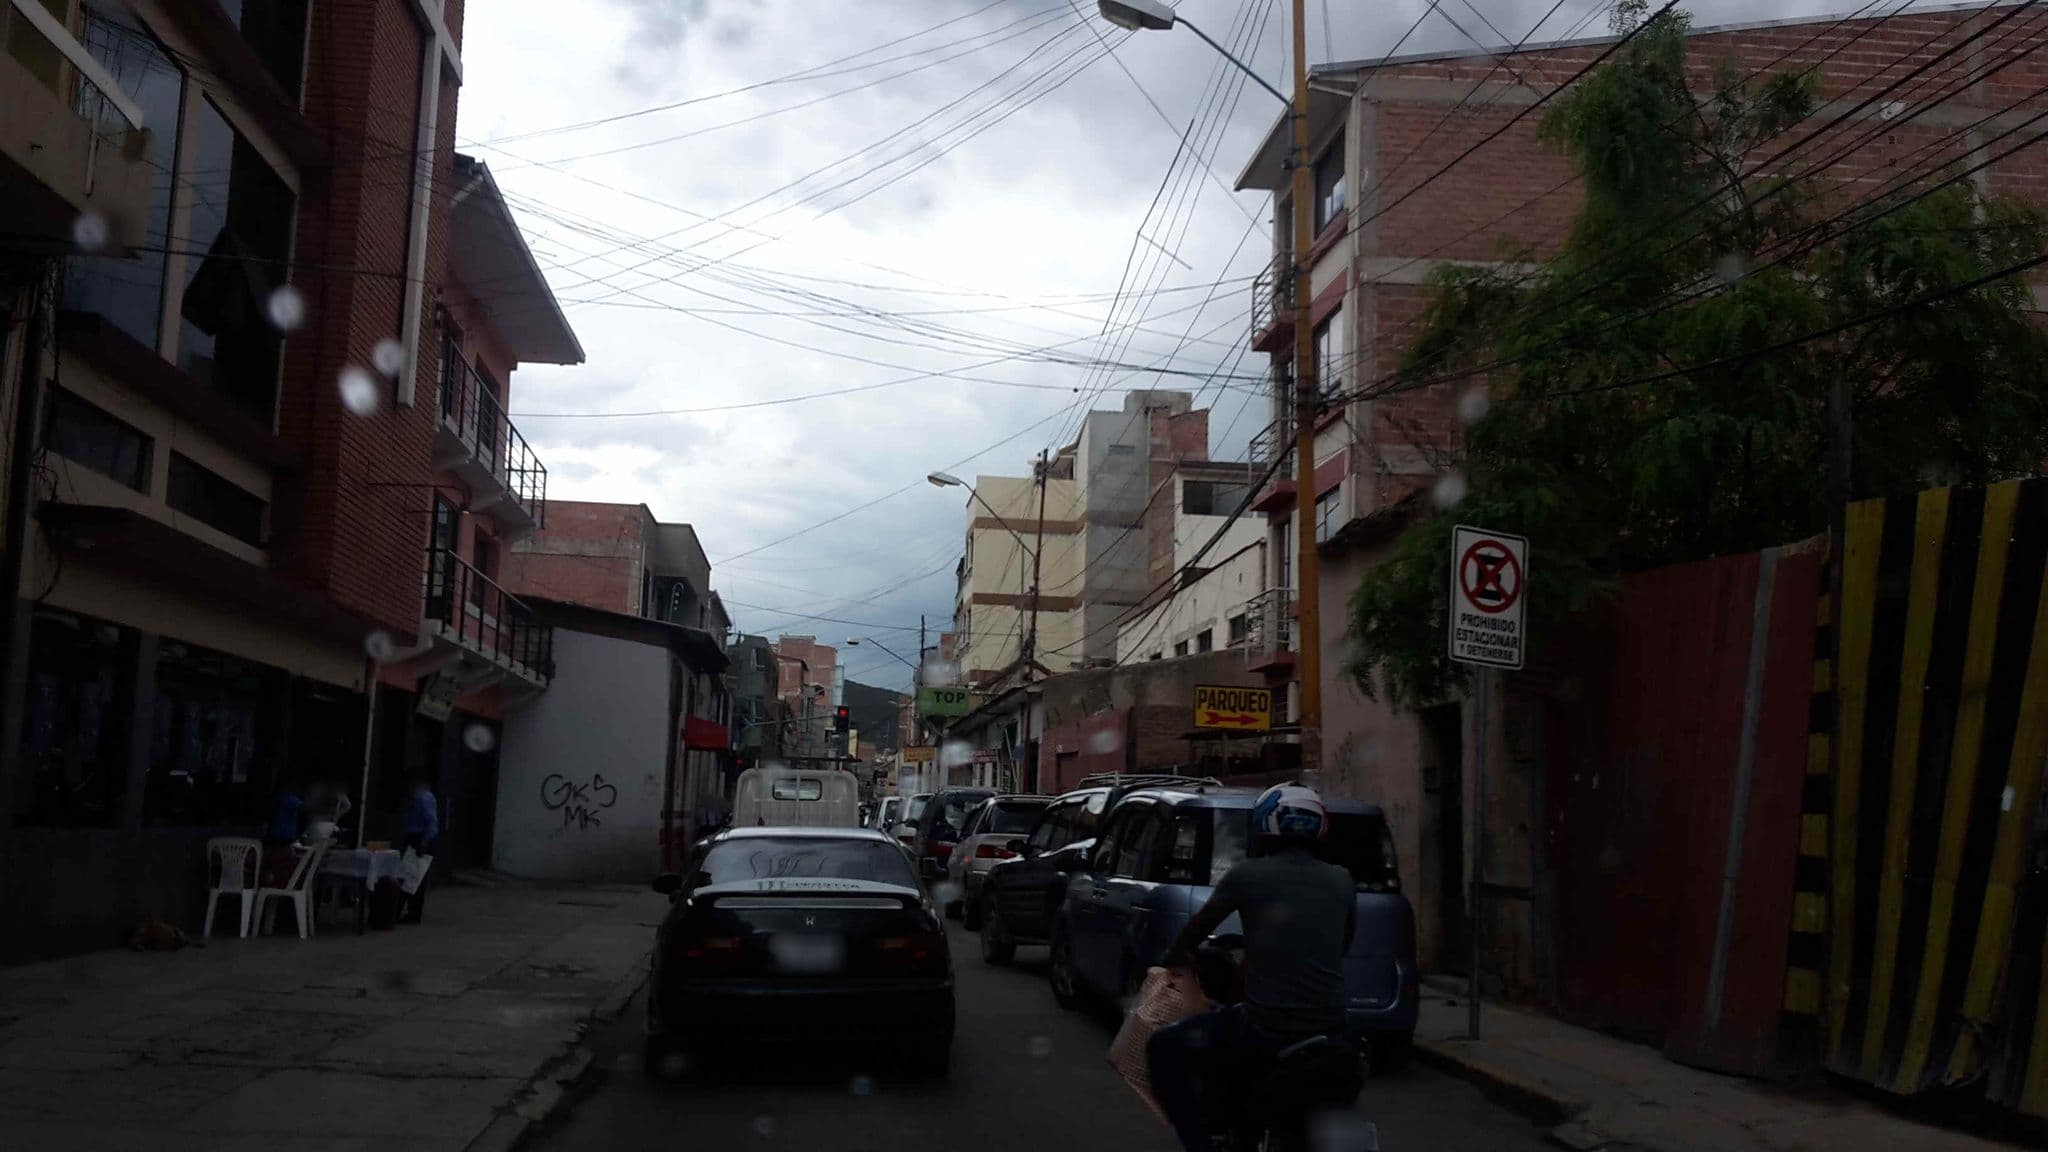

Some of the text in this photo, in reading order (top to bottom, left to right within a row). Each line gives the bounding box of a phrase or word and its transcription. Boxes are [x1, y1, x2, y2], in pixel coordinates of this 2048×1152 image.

[1461, 613, 1515, 633] PROHIBIDO
[1456, 628, 1518, 649] ESTACIONAR
[934, 691, 965, 703] TOP
[1198, 689, 1268, 713] PARQUEO
